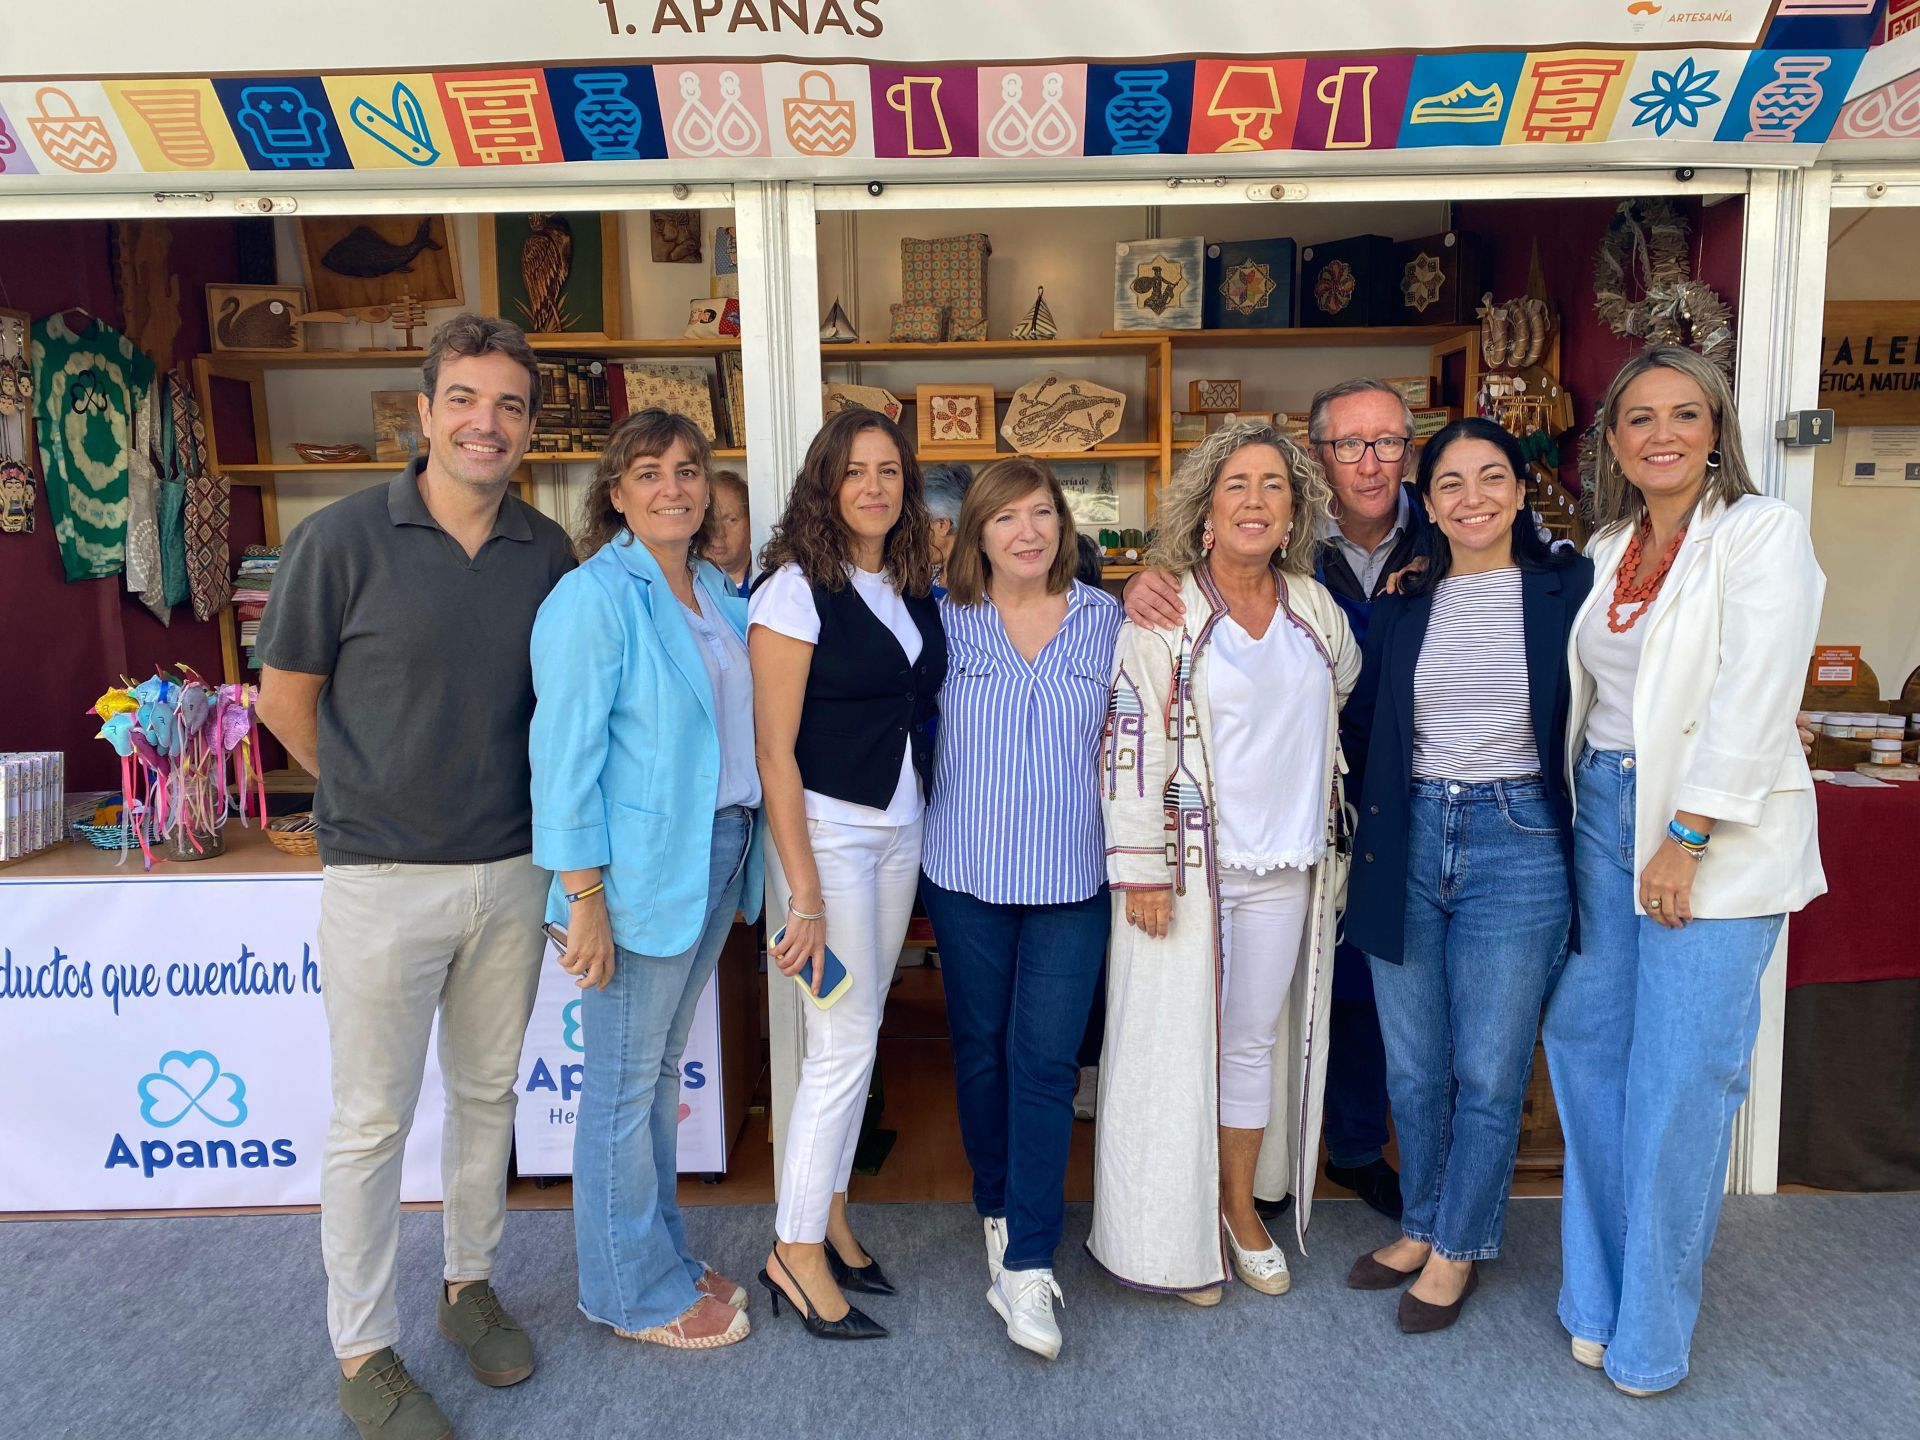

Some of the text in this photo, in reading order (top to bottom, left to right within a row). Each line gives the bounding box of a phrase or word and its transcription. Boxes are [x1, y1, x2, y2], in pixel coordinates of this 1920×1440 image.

[598, 0, 884, 38] 1. APANAS
[1667, 9, 1733, 23] ARTESANÍA
[101, 964, 160, 1016] que
[166, 943, 296, 996] cuentan
[104, 1132, 297, 1178] Apanas
